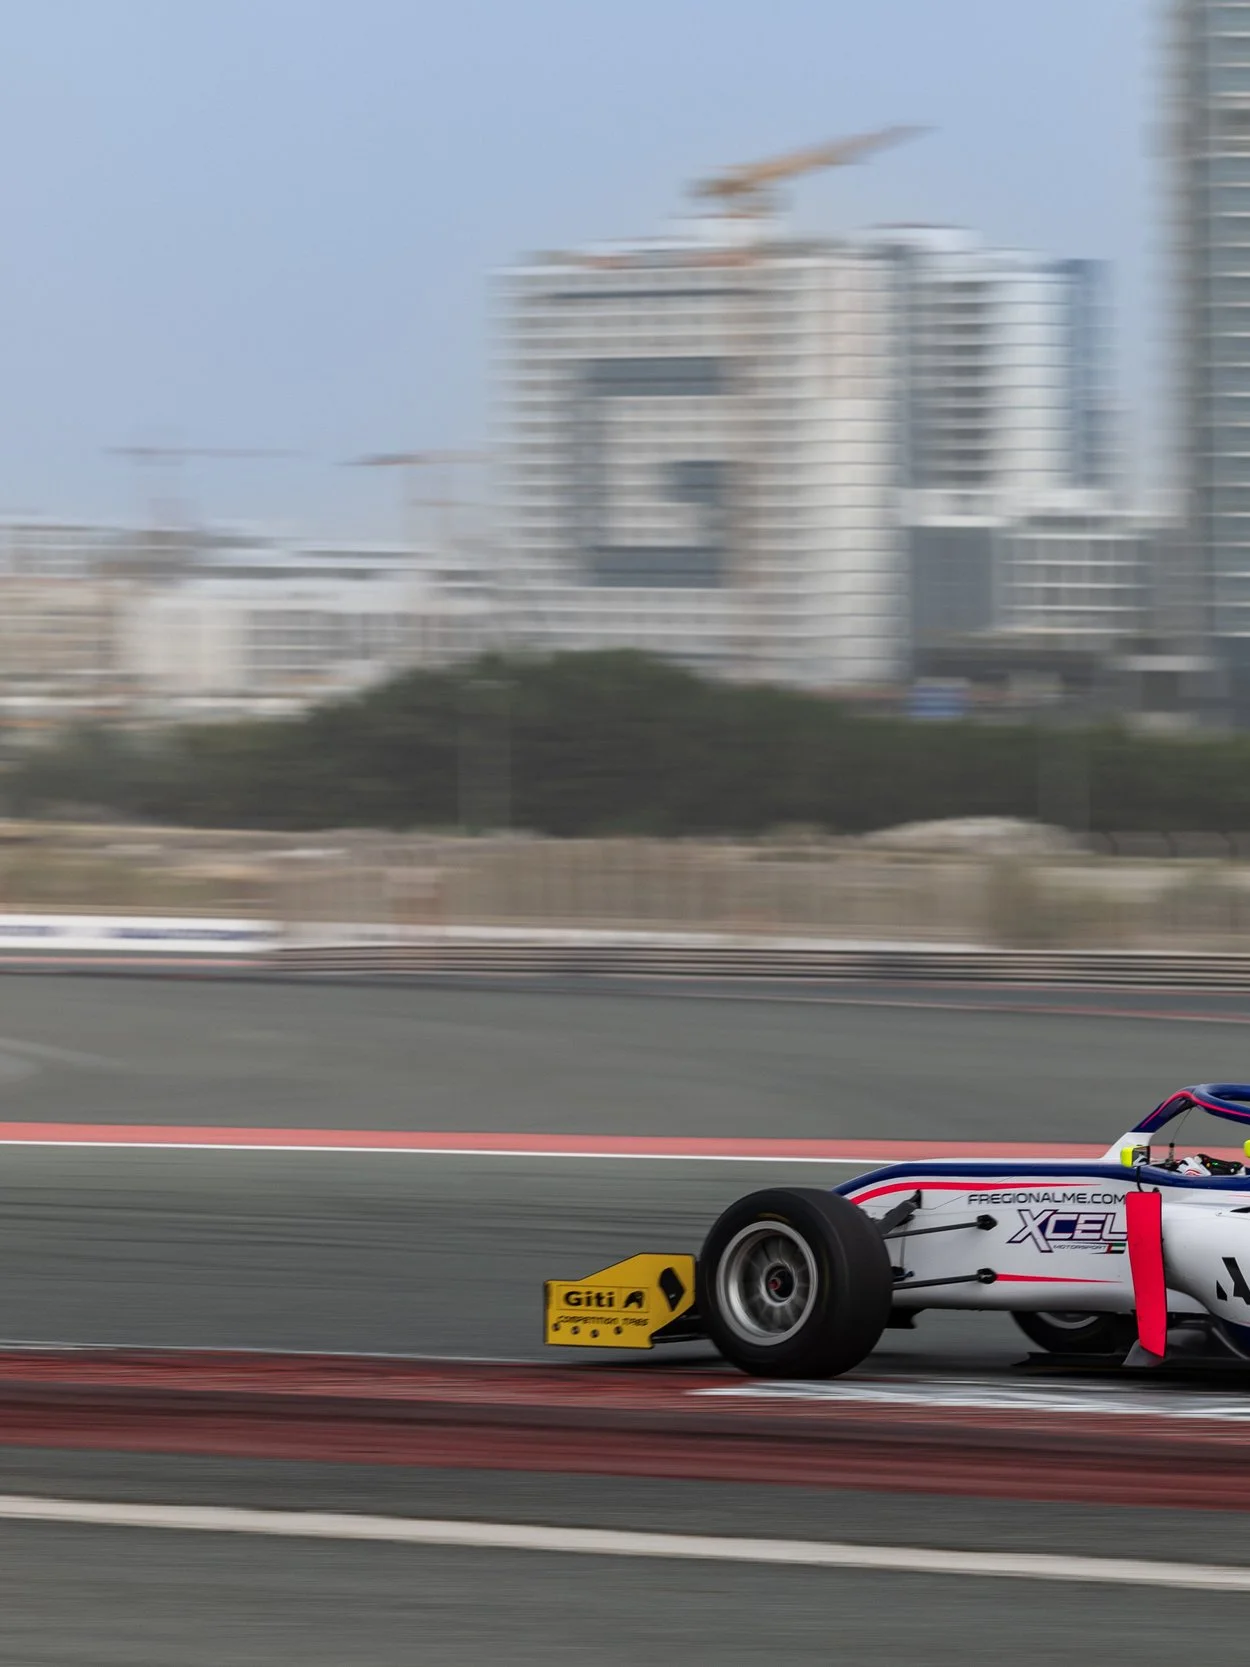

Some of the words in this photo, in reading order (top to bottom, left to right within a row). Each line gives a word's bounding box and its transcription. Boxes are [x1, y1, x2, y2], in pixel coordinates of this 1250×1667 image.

[967, 1192, 1127, 1205] FREGIONALME.COM
[1006, 1208, 1129, 1253] XCEL
[564, 1290, 615, 1308] Giti
